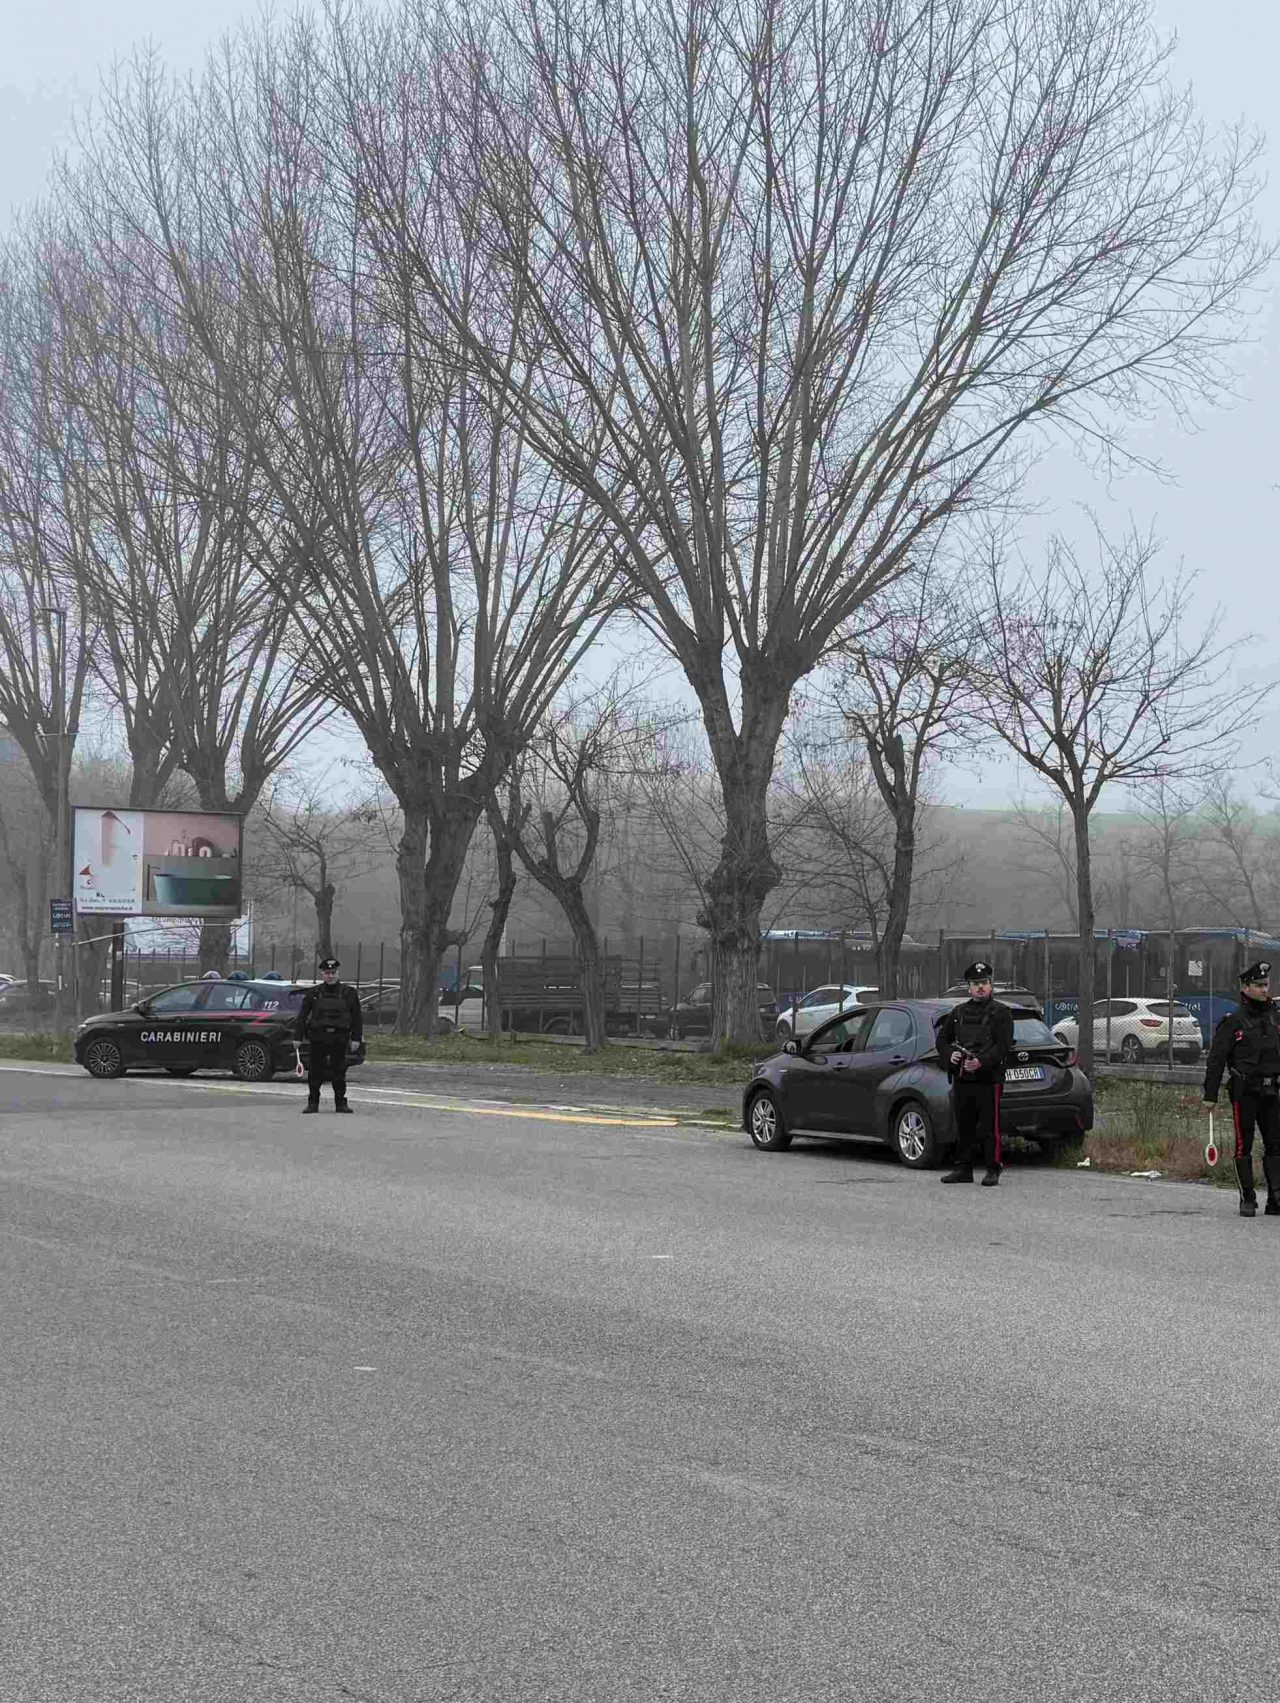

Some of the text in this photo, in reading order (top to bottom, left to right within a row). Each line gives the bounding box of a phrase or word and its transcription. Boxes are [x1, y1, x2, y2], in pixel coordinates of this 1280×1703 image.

[262, 1001, 280, 1010] 112
[1055, 1001, 1078, 1012] cotra
[140, 1031, 222, 1043] CARABINIERI
